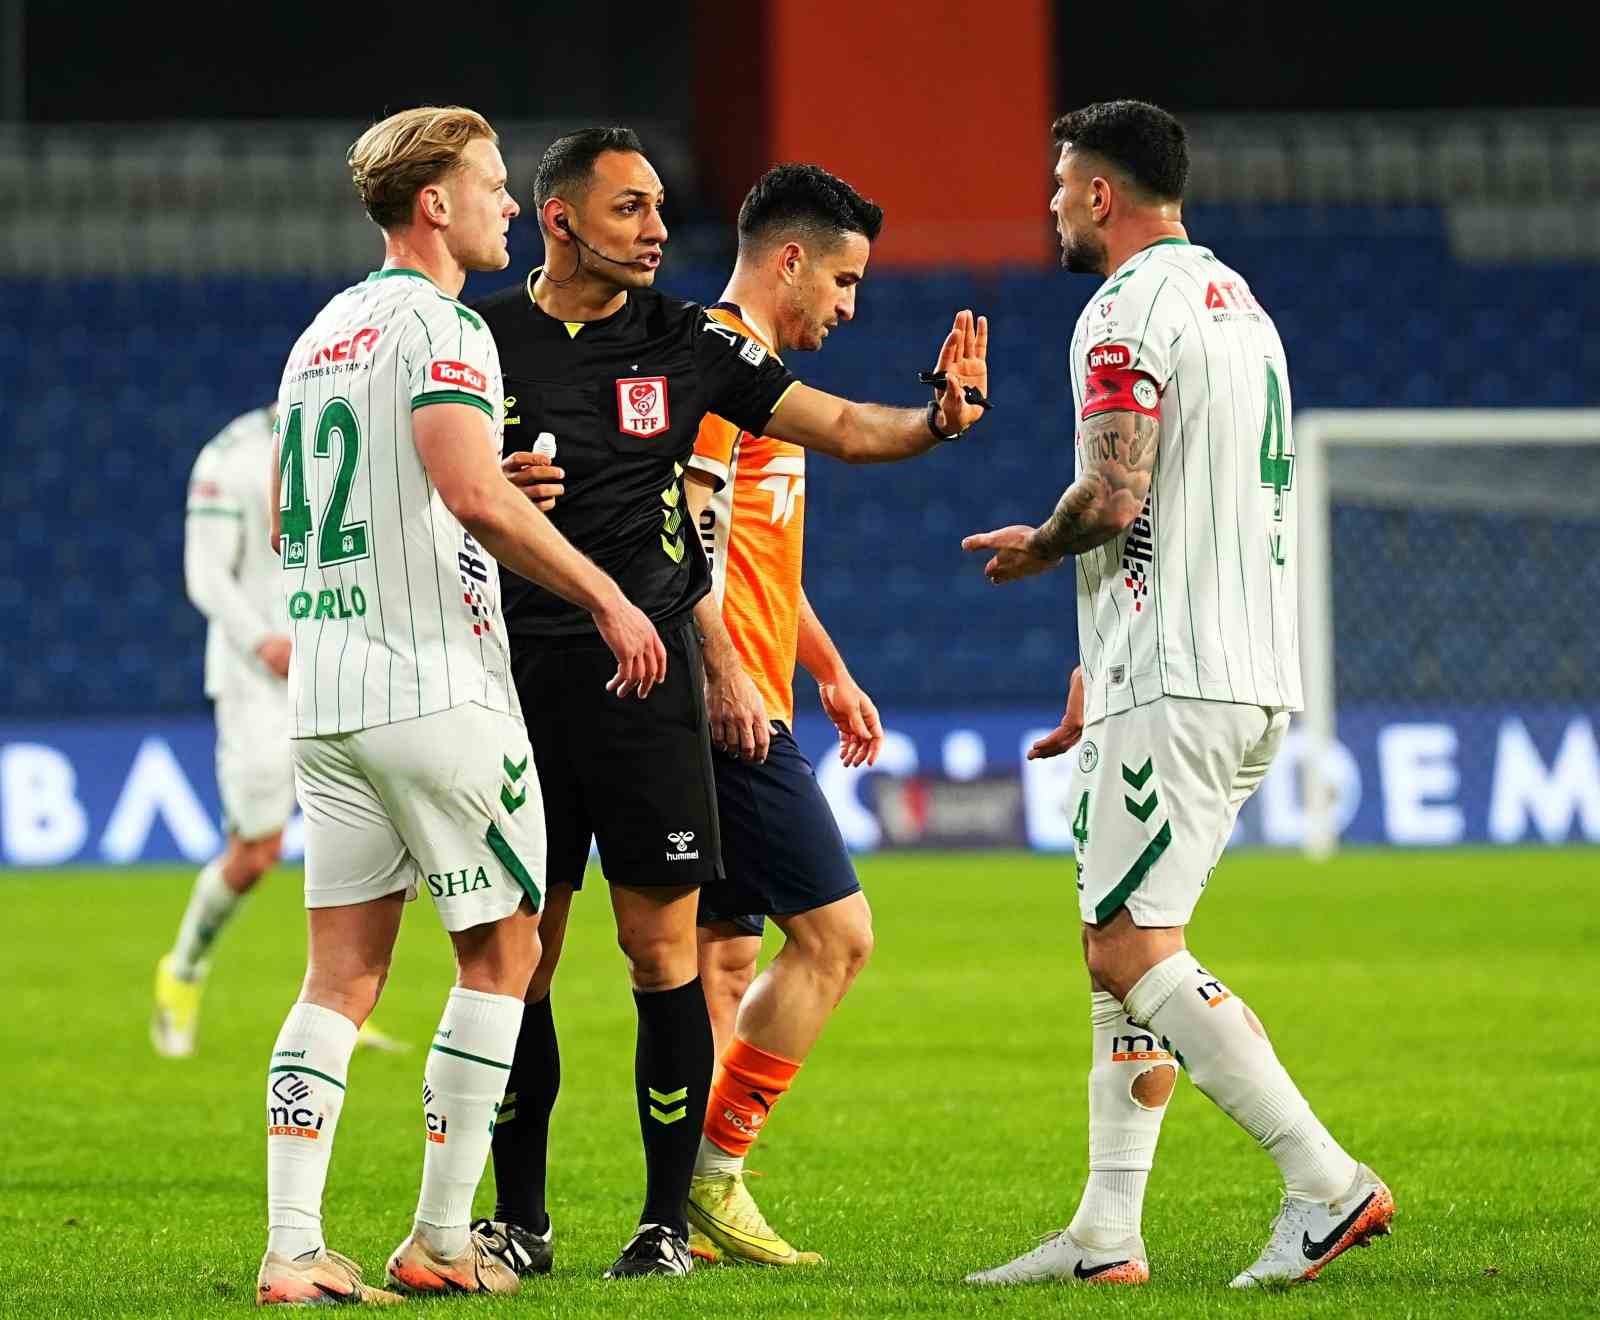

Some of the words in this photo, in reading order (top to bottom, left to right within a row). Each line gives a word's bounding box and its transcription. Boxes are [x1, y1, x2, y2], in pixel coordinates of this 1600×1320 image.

[345, 361, 368, 373] TANS
[437, 364, 482, 388] Torku
[630, 417, 658, 430] TFF
[1259, 355, 1295, 521] 4
[280, 397, 370, 569] 42
[1072, 789, 1089, 854] 4
[666, 849, 699, 861] hummel
[428, 866, 492, 897] SHA
